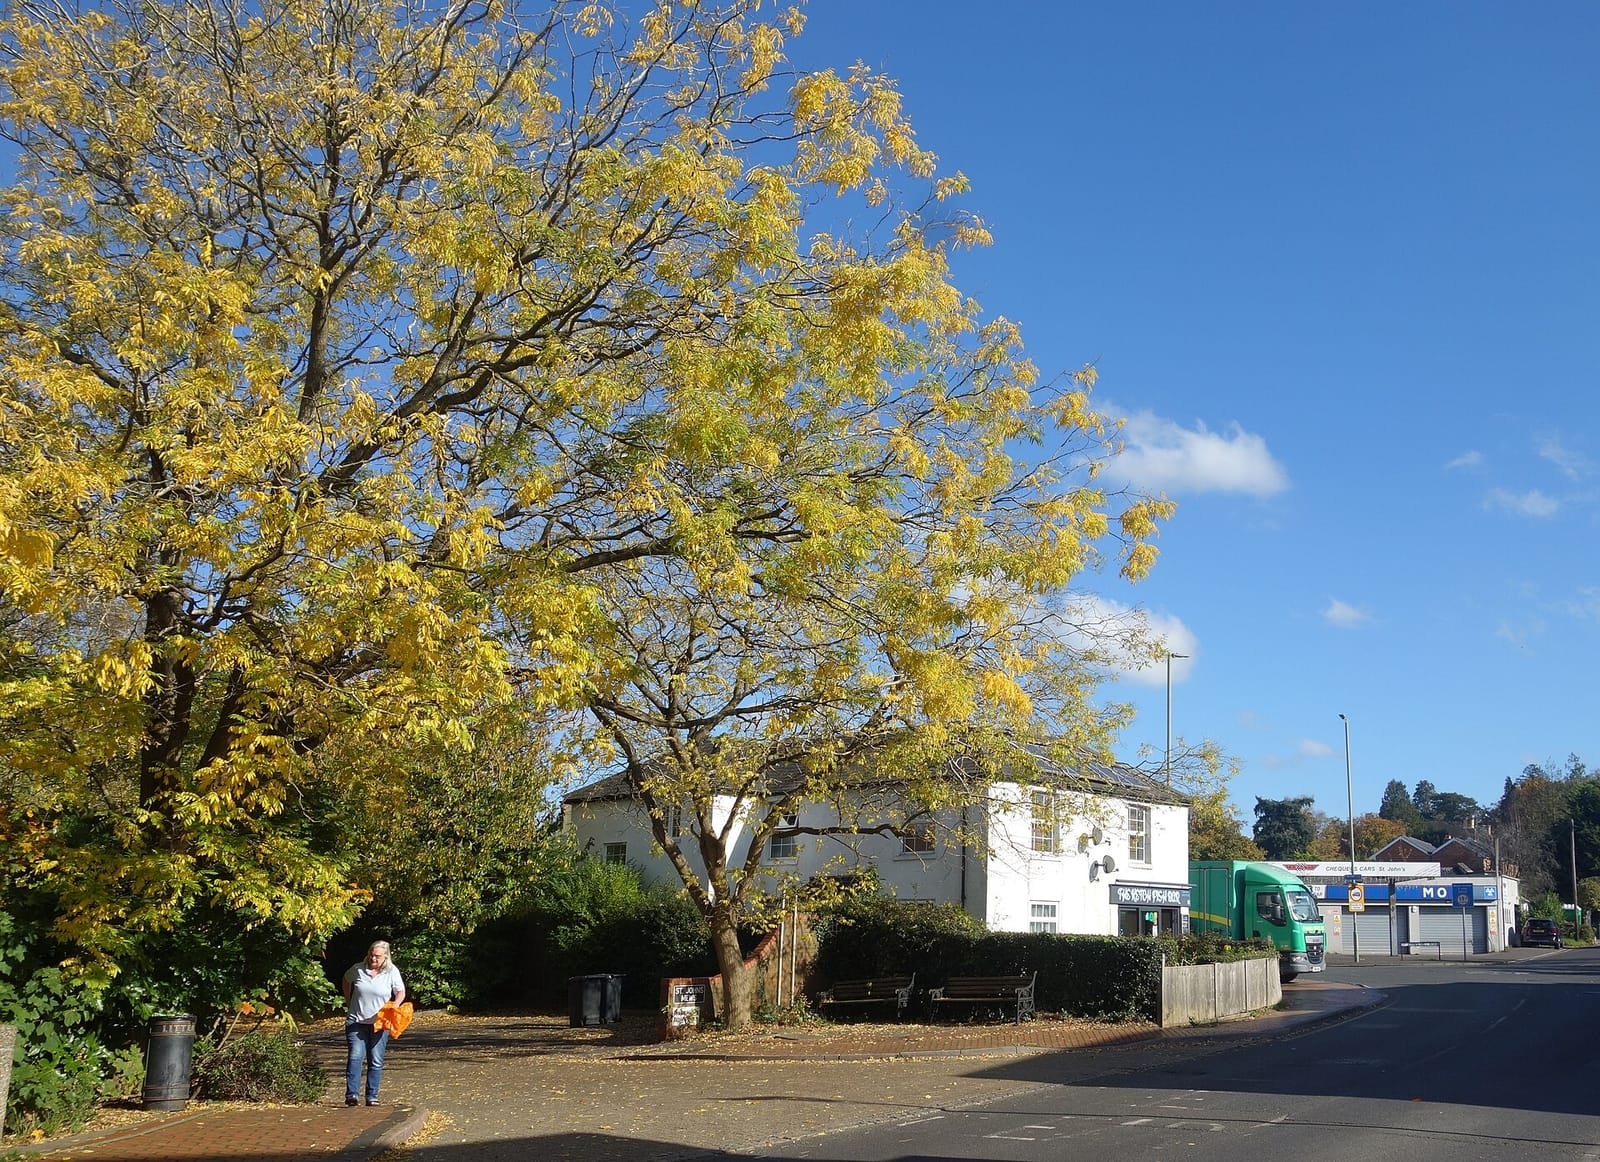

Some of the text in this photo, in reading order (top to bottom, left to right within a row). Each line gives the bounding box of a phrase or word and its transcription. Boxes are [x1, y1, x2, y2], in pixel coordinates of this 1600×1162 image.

[1151, 889, 1168, 904] FISH
[1167, 890, 1181, 905] BAR
[1422, 887, 1447, 898] MO
[162, 1024, 194, 1033] LITTE
